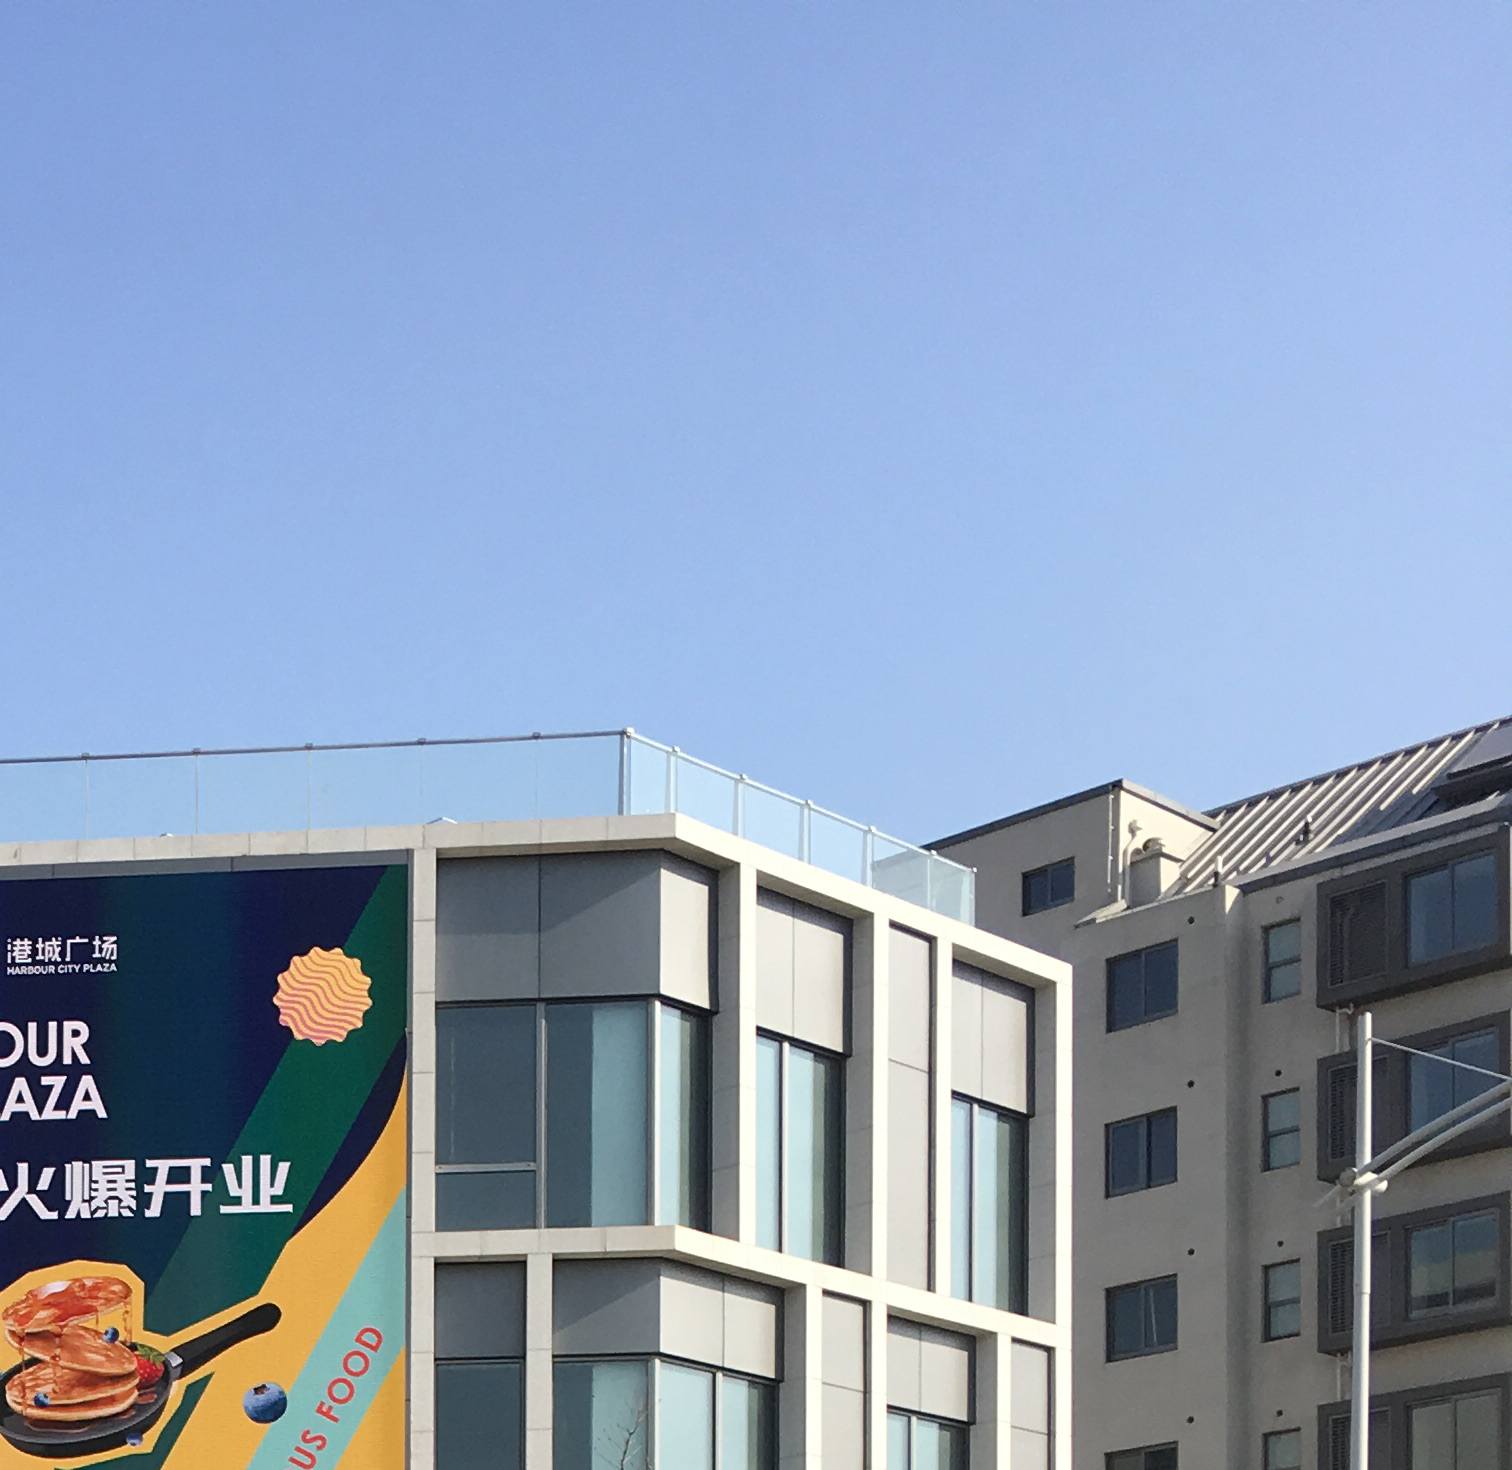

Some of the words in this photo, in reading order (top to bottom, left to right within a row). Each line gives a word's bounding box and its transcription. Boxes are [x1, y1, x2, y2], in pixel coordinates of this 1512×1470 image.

[7, 935, 117, 963] 港城广场
[7, 965, 55, 975] HARBOUR
[57, 963, 81, 973] CITY
[82, 962, 117, 972] PLAZA
[315, 1326, 383, 1423] FOOD
